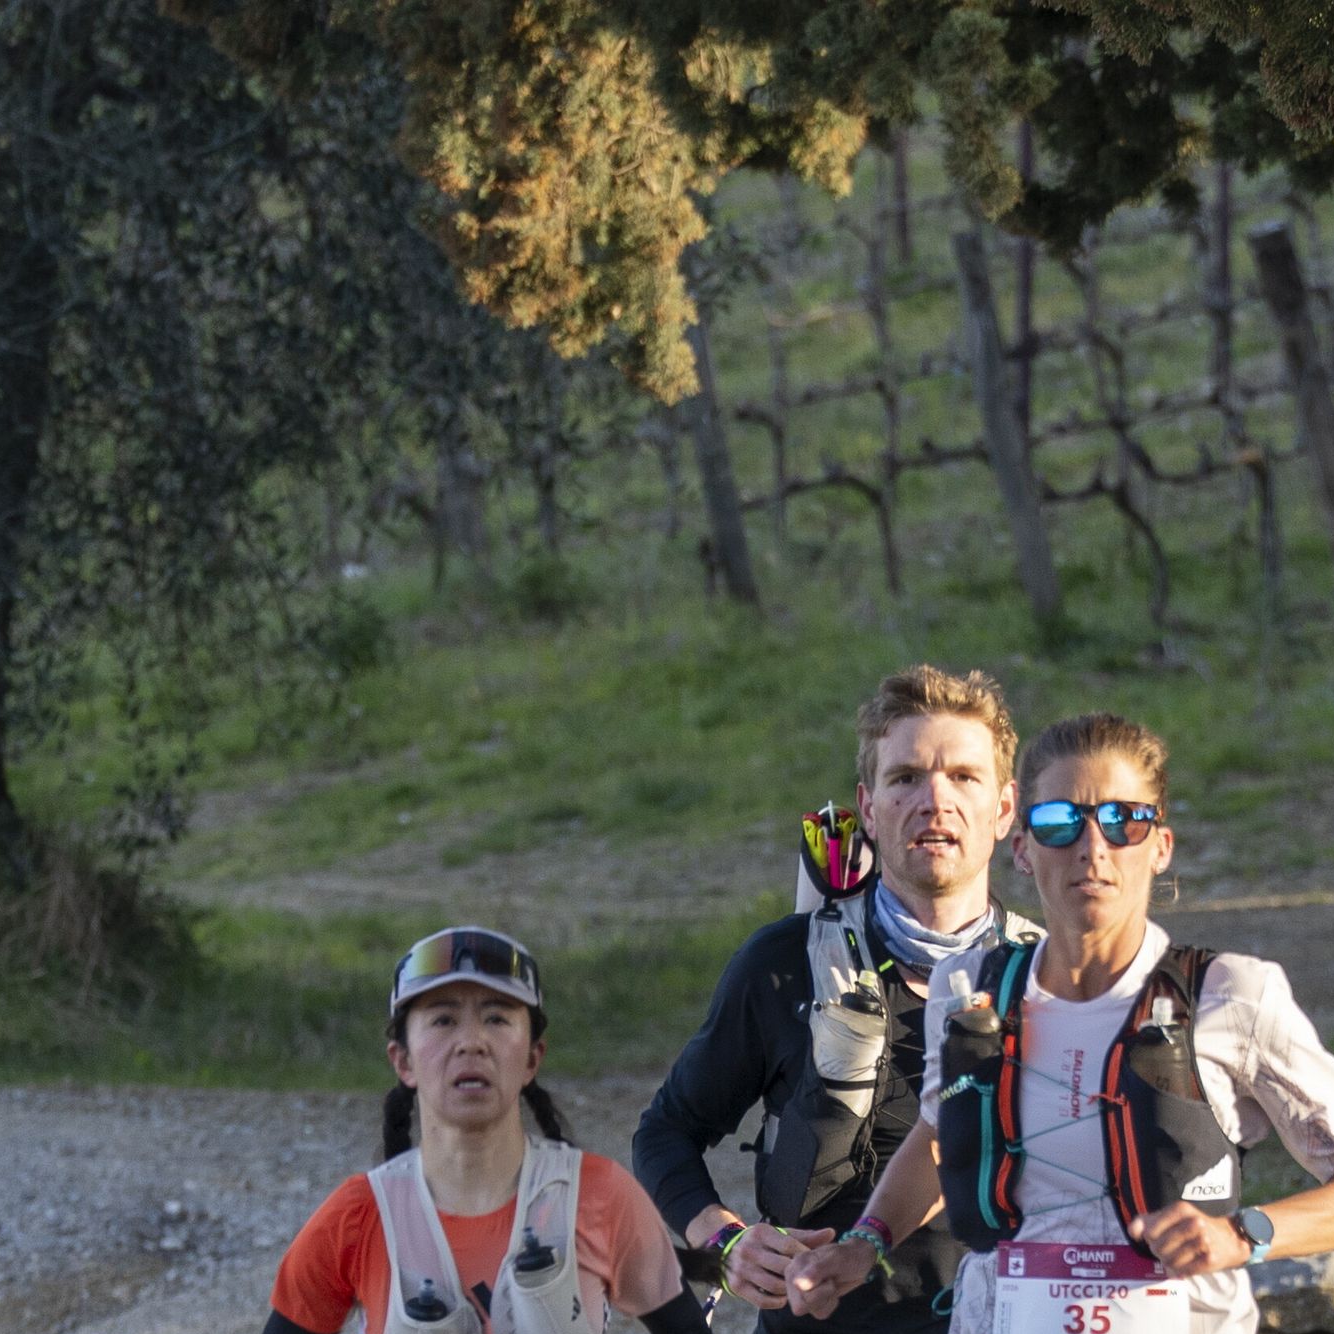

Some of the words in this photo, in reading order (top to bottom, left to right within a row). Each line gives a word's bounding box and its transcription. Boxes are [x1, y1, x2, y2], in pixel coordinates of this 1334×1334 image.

[1071, 1049, 1084, 1119] SALOMON
[1063, 1247, 1115, 1265] CHIANTI
[1049, 1284, 1129, 1299] UTCC120
